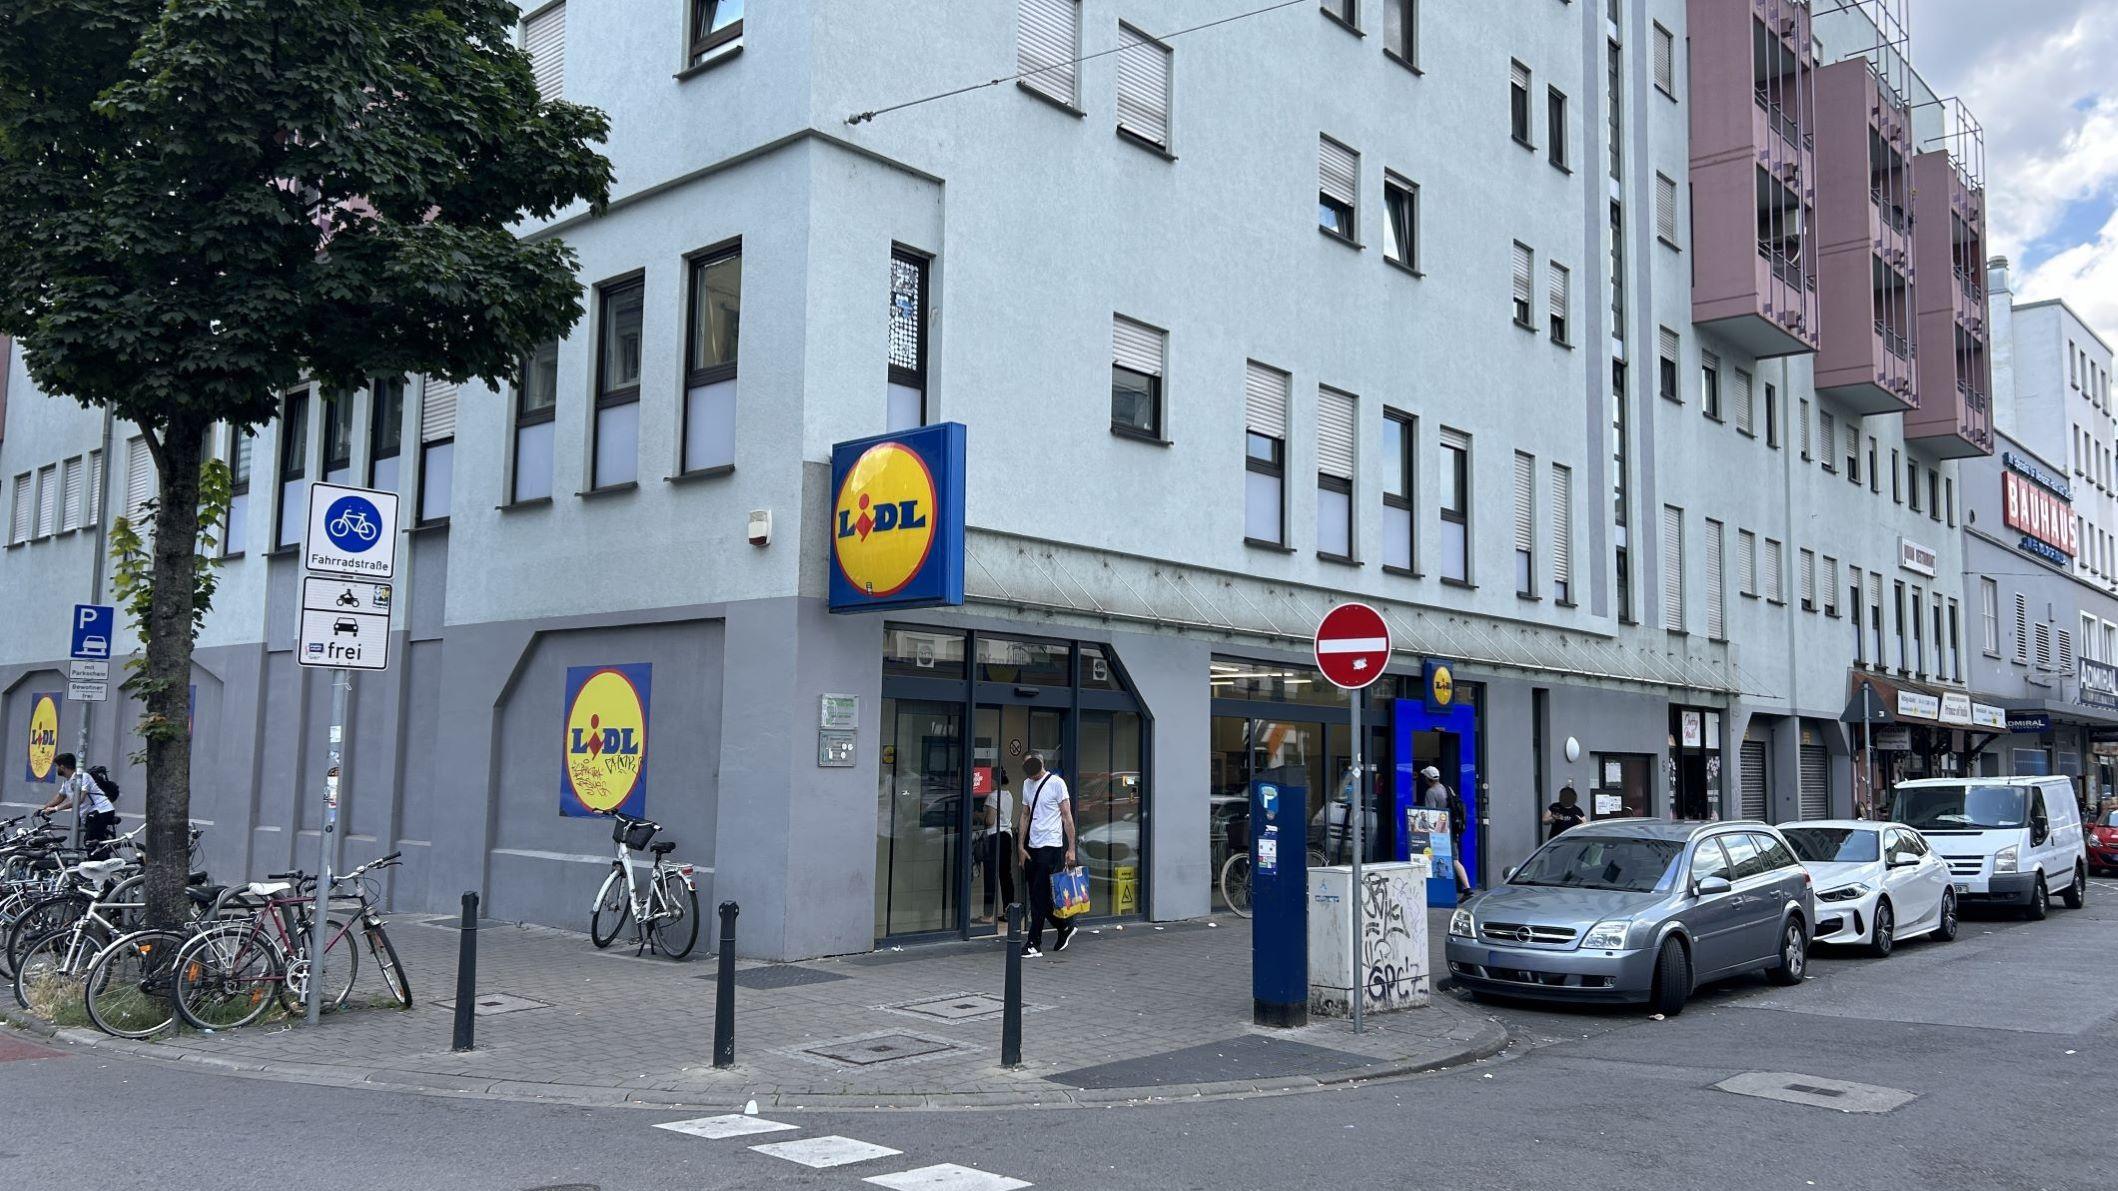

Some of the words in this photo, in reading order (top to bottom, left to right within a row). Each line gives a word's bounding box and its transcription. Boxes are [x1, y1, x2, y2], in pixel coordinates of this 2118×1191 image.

[2008, 480, 2077, 549] BAUHAUS
[312, 553, 389, 571] Fahrradstraße
[79, 608, 98, 629] P
[328, 641, 362, 660] frei
